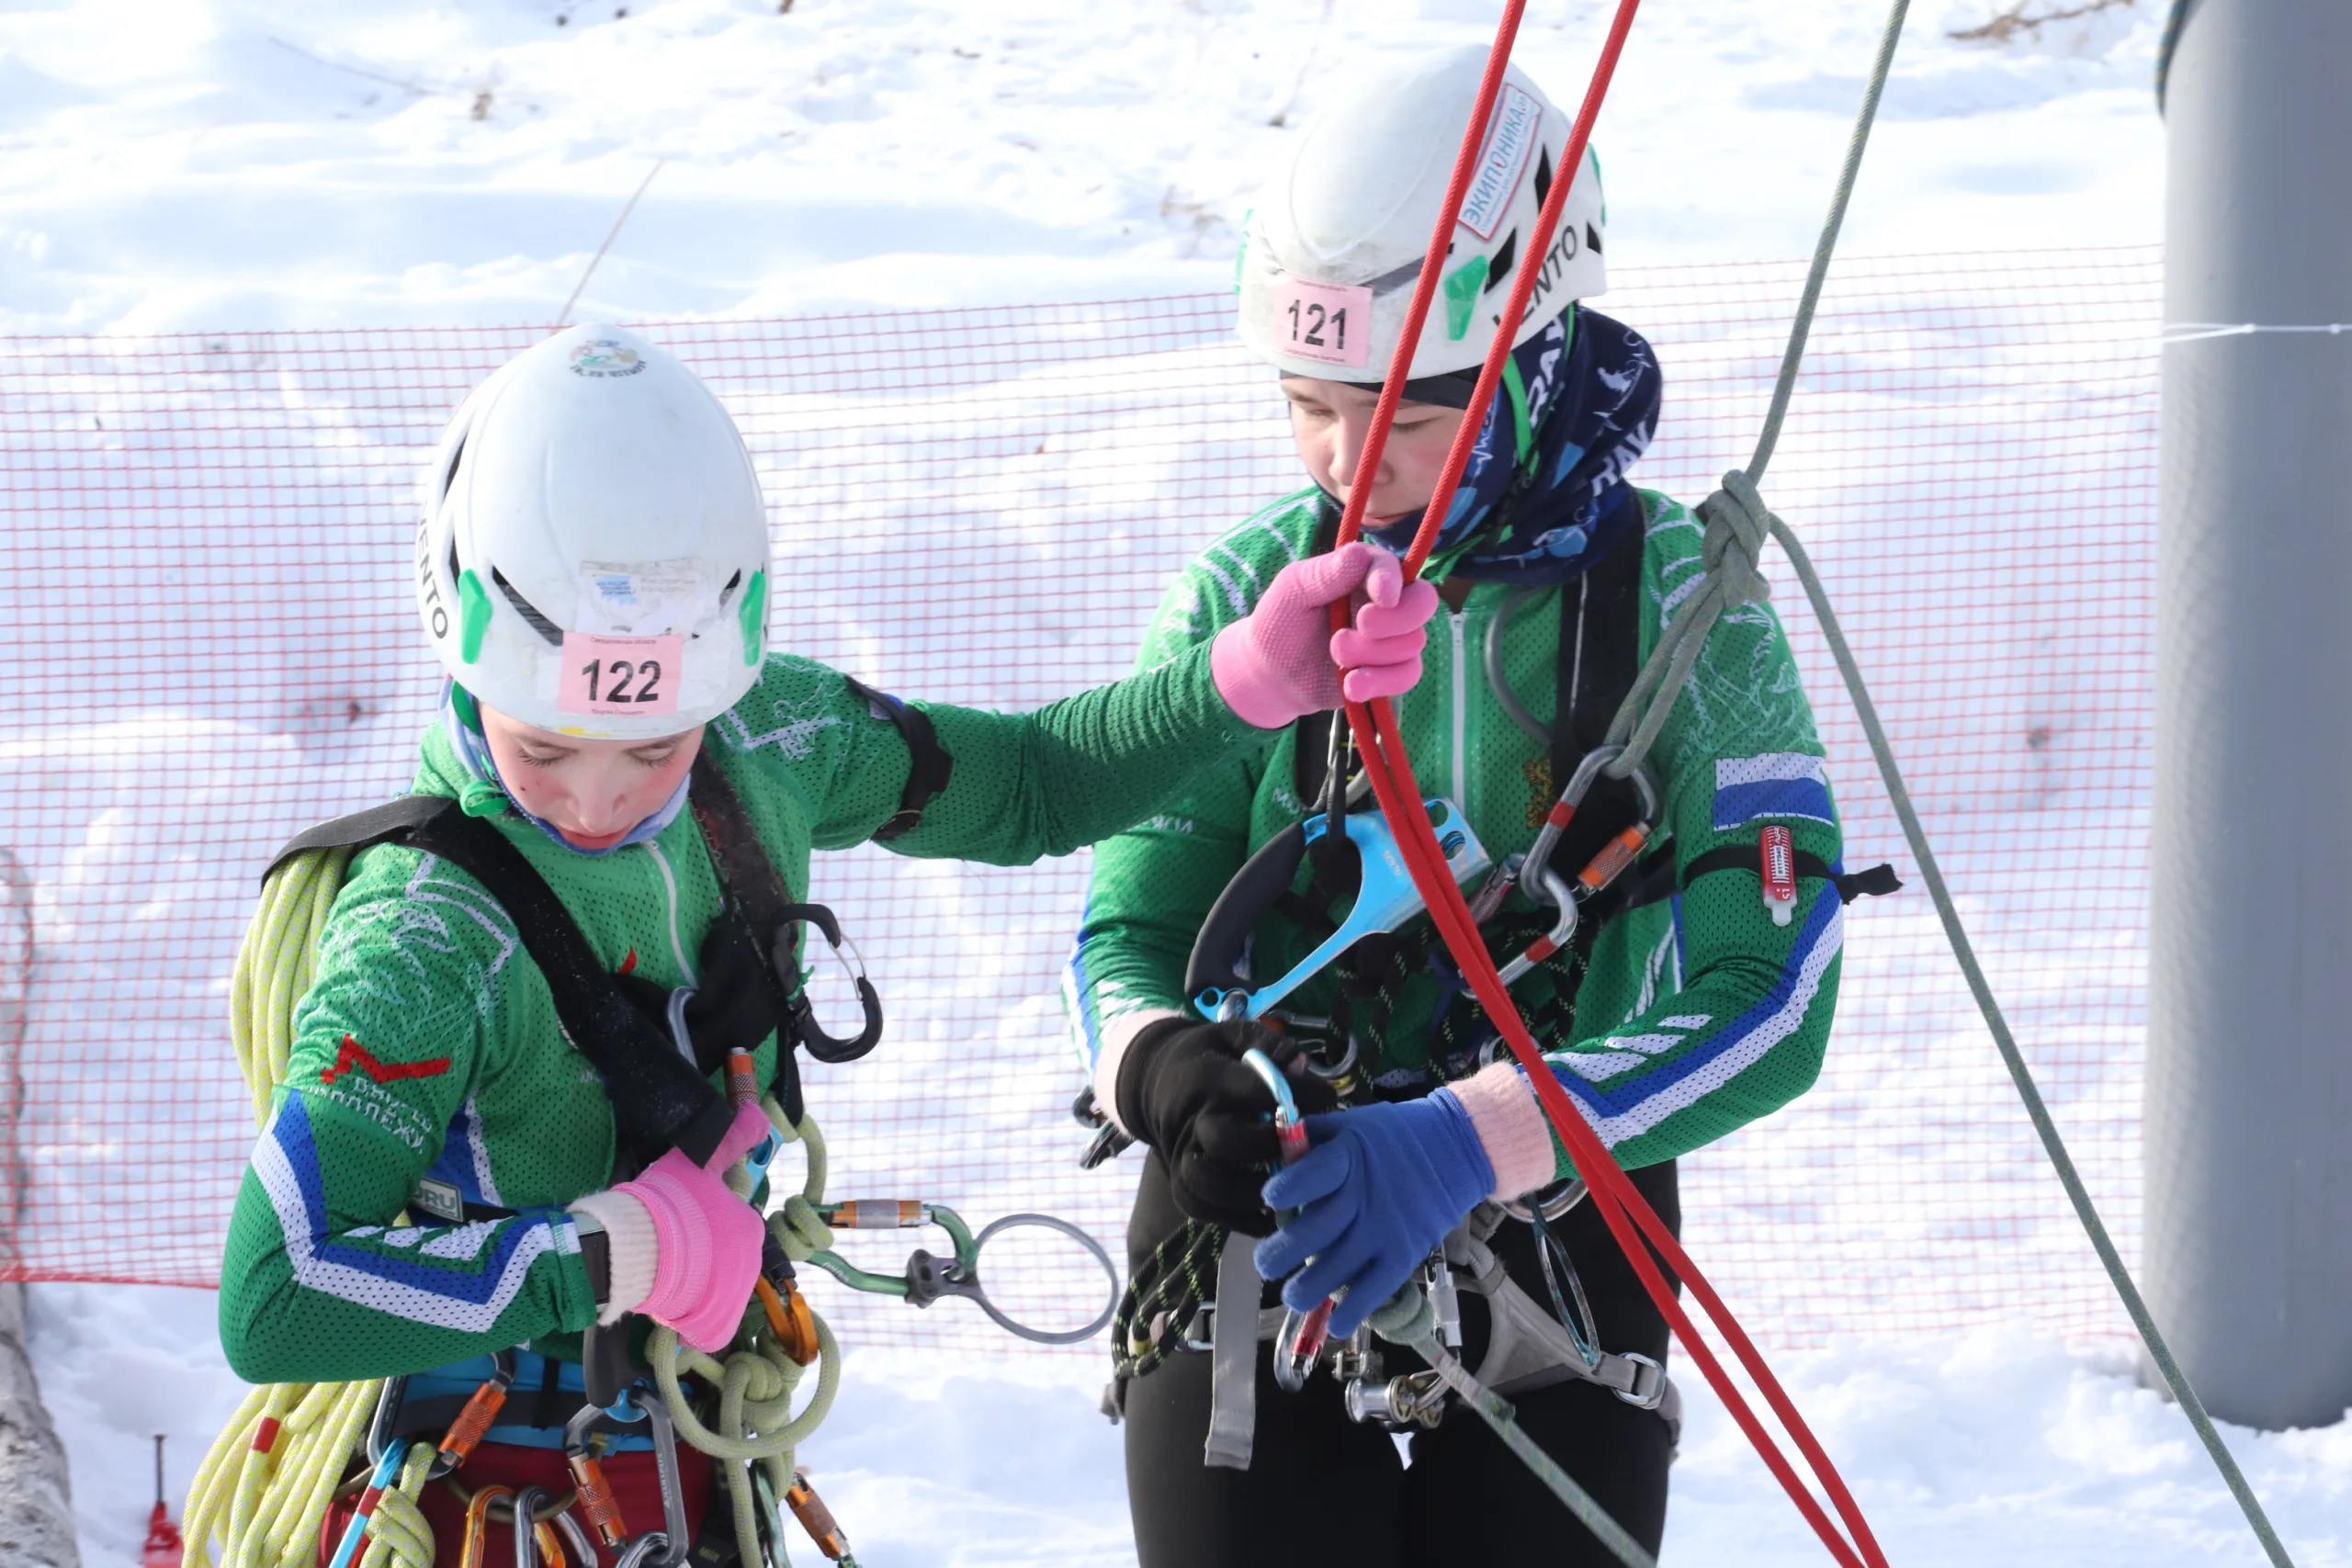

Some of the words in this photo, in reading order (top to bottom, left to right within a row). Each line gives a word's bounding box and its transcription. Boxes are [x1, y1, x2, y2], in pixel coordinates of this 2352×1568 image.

[1492, 225, 1577, 327] NTO
[1288, 299, 1347, 350] 121
[582, 658, 662, 704] 122
